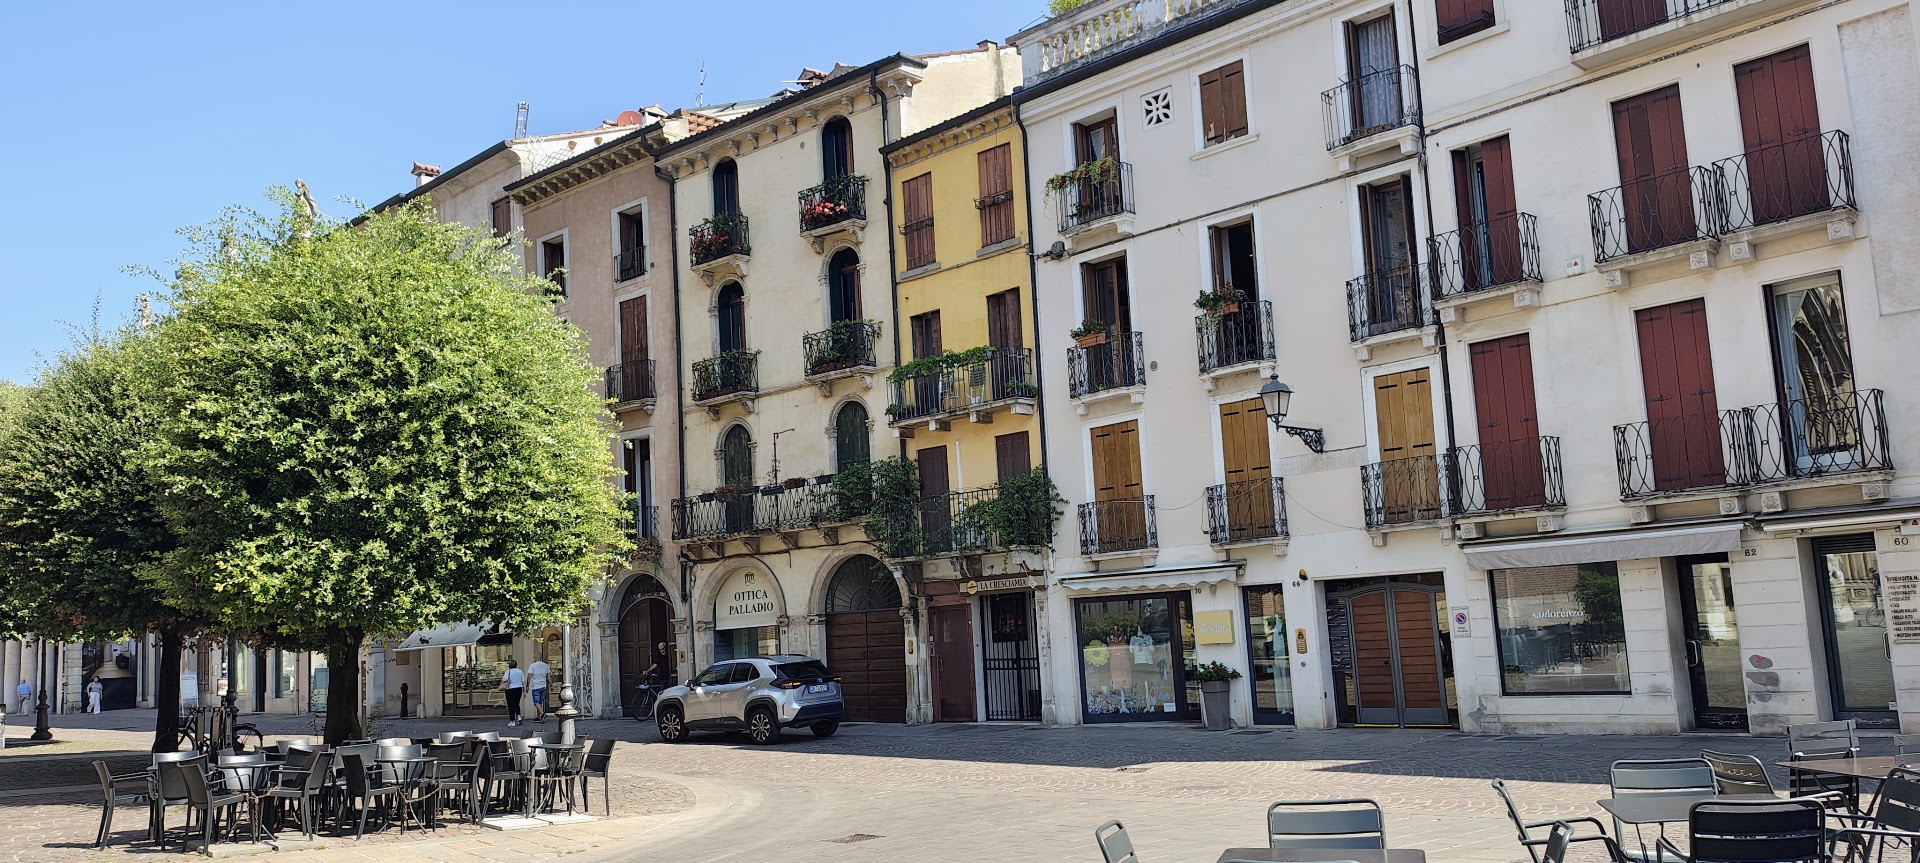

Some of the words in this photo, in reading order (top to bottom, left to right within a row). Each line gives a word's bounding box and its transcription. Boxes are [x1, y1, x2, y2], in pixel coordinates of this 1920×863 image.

[1894, 537, 1909, 545] 60
[1744, 548, 1757, 556] 62
[980, 582, 988, 590] LA
[734, 589, 768, 601] OTTICA
[729, 602, 773, 615] PALLADIO
[1531, 609, 1585, 619] sanlorenzo
